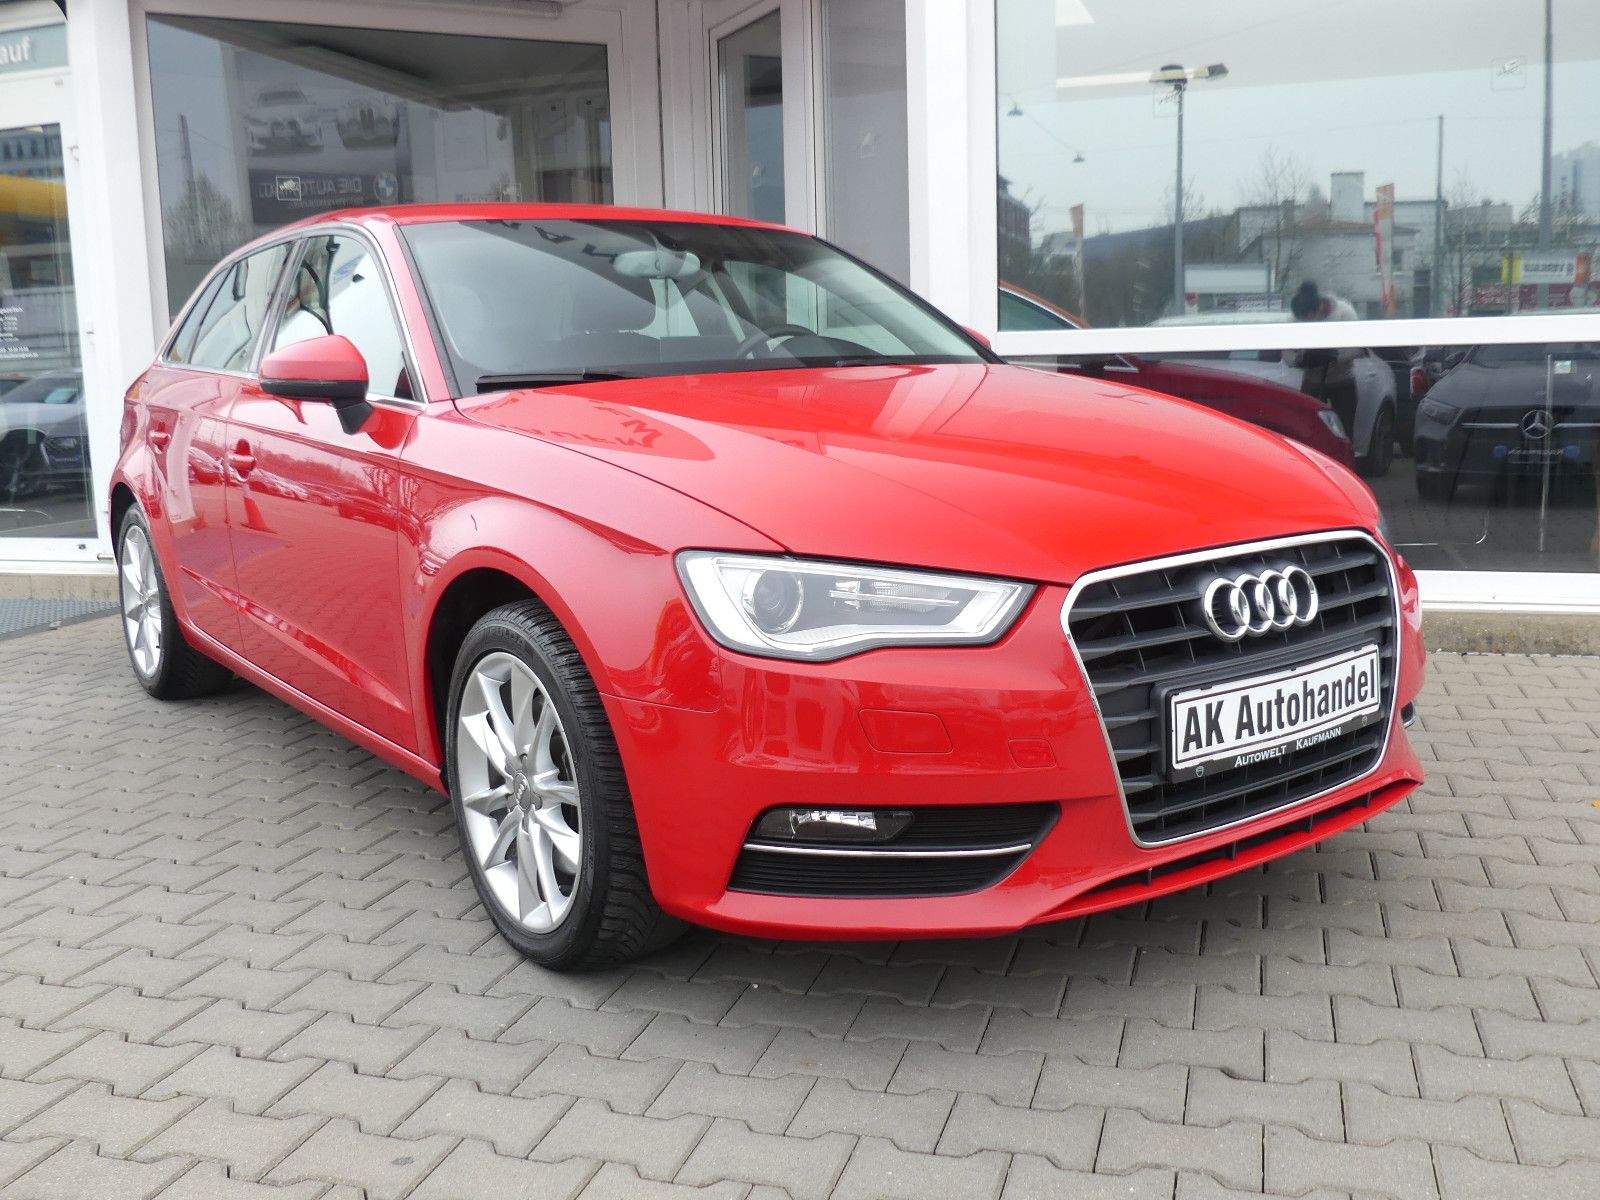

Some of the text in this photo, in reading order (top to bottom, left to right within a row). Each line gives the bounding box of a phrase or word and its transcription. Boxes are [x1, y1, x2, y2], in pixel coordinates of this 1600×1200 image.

[1181, 658, 1376, 753] AK Autohandel
[1234, 726, 1342, 768] AUTOWELT KAUFMANN
